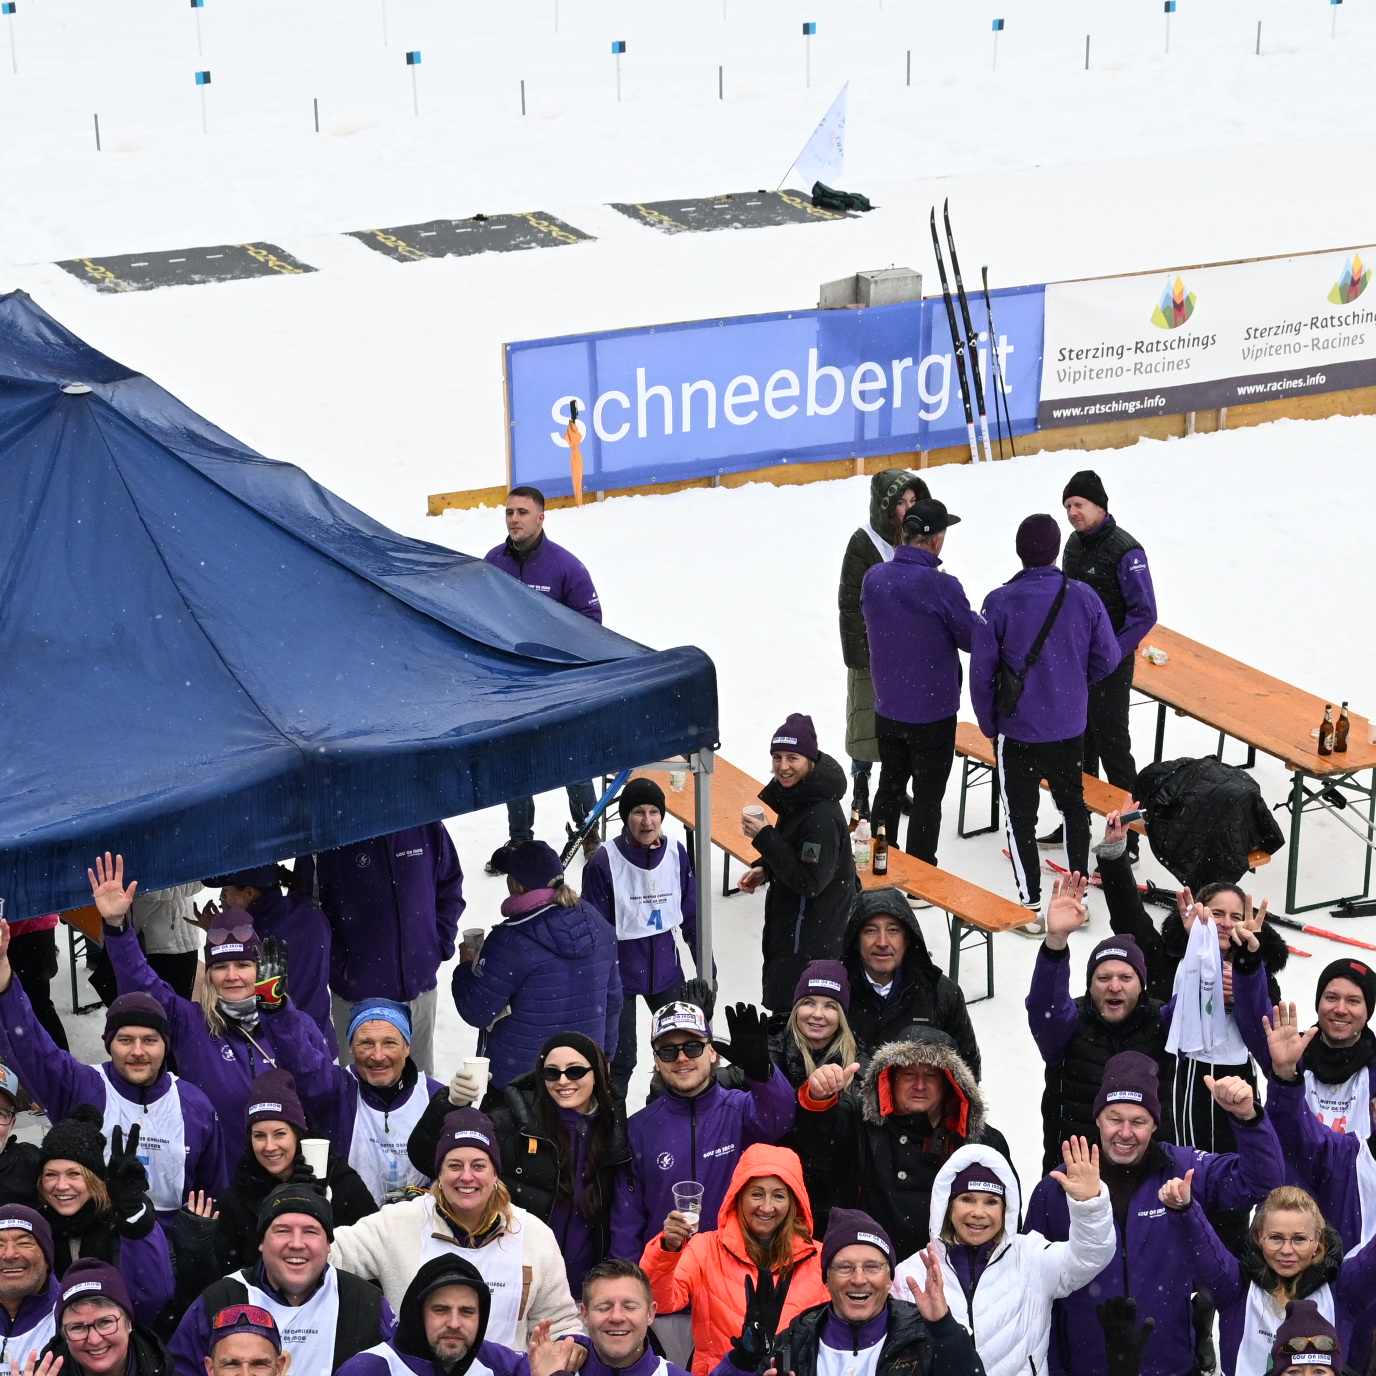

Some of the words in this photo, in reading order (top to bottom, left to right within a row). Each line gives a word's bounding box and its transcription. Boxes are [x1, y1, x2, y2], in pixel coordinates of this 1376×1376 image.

[1057, 333, 1217, 363] Sterzing-Ratschings
[1242, 332, 1366, 362] Vipiteno-Racines
[1056, 356, 1191, 385] Vipiteno-Racines
[1237, 372, 1327, 396] www.racines.info
[551, 331, 1015, 450] schneeberg.it
[1052, 394, 1166, 420] www.ratschings.info
[646, 909, 663, 930] 4
